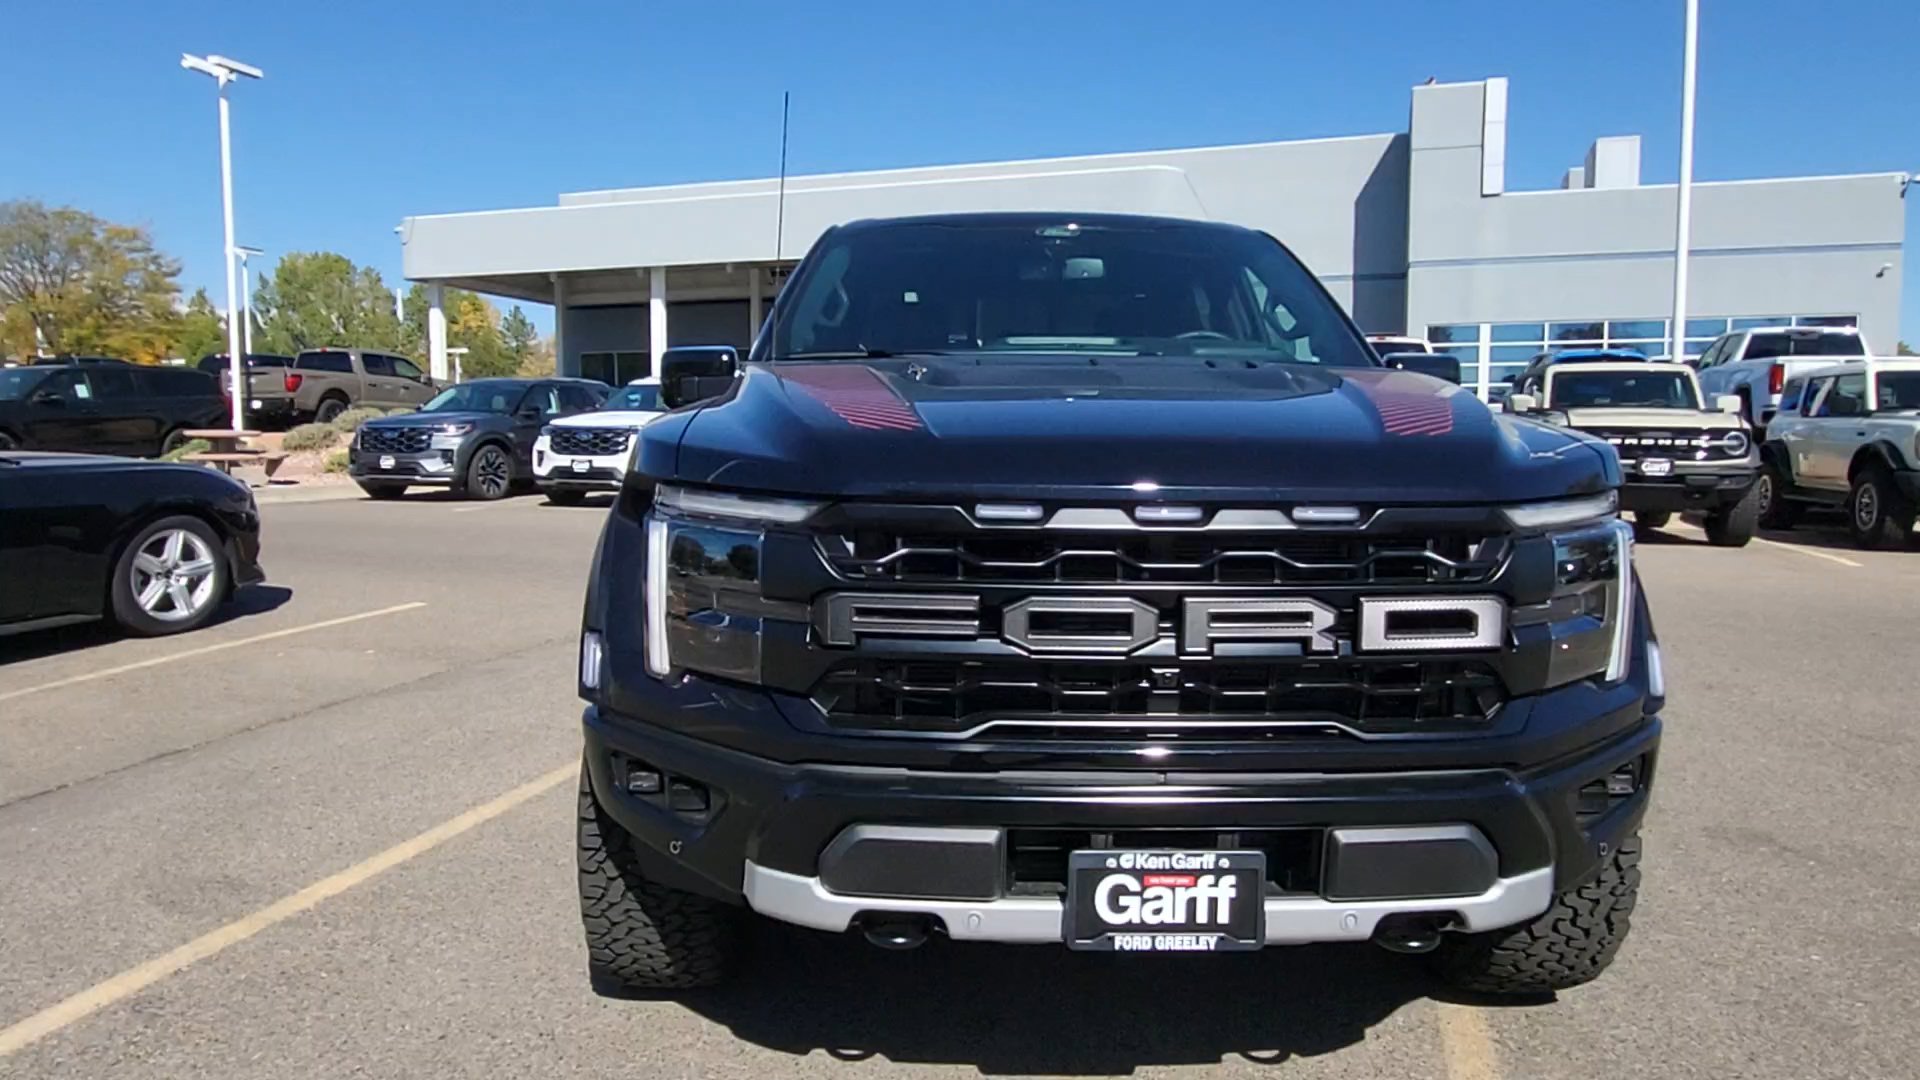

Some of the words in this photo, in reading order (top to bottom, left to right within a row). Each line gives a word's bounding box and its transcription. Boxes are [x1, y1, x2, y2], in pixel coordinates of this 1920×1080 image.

[816, 593, 1504, 657] FORD
[1135, 853, 1170, 869] Ken
[1171, 853, 1216, 869] Garff
[1094, 873, 1236, 924] Garff
[1114, 935, 1152, 950] FORD
[1154, 935, 1218, 950] GREELEY
